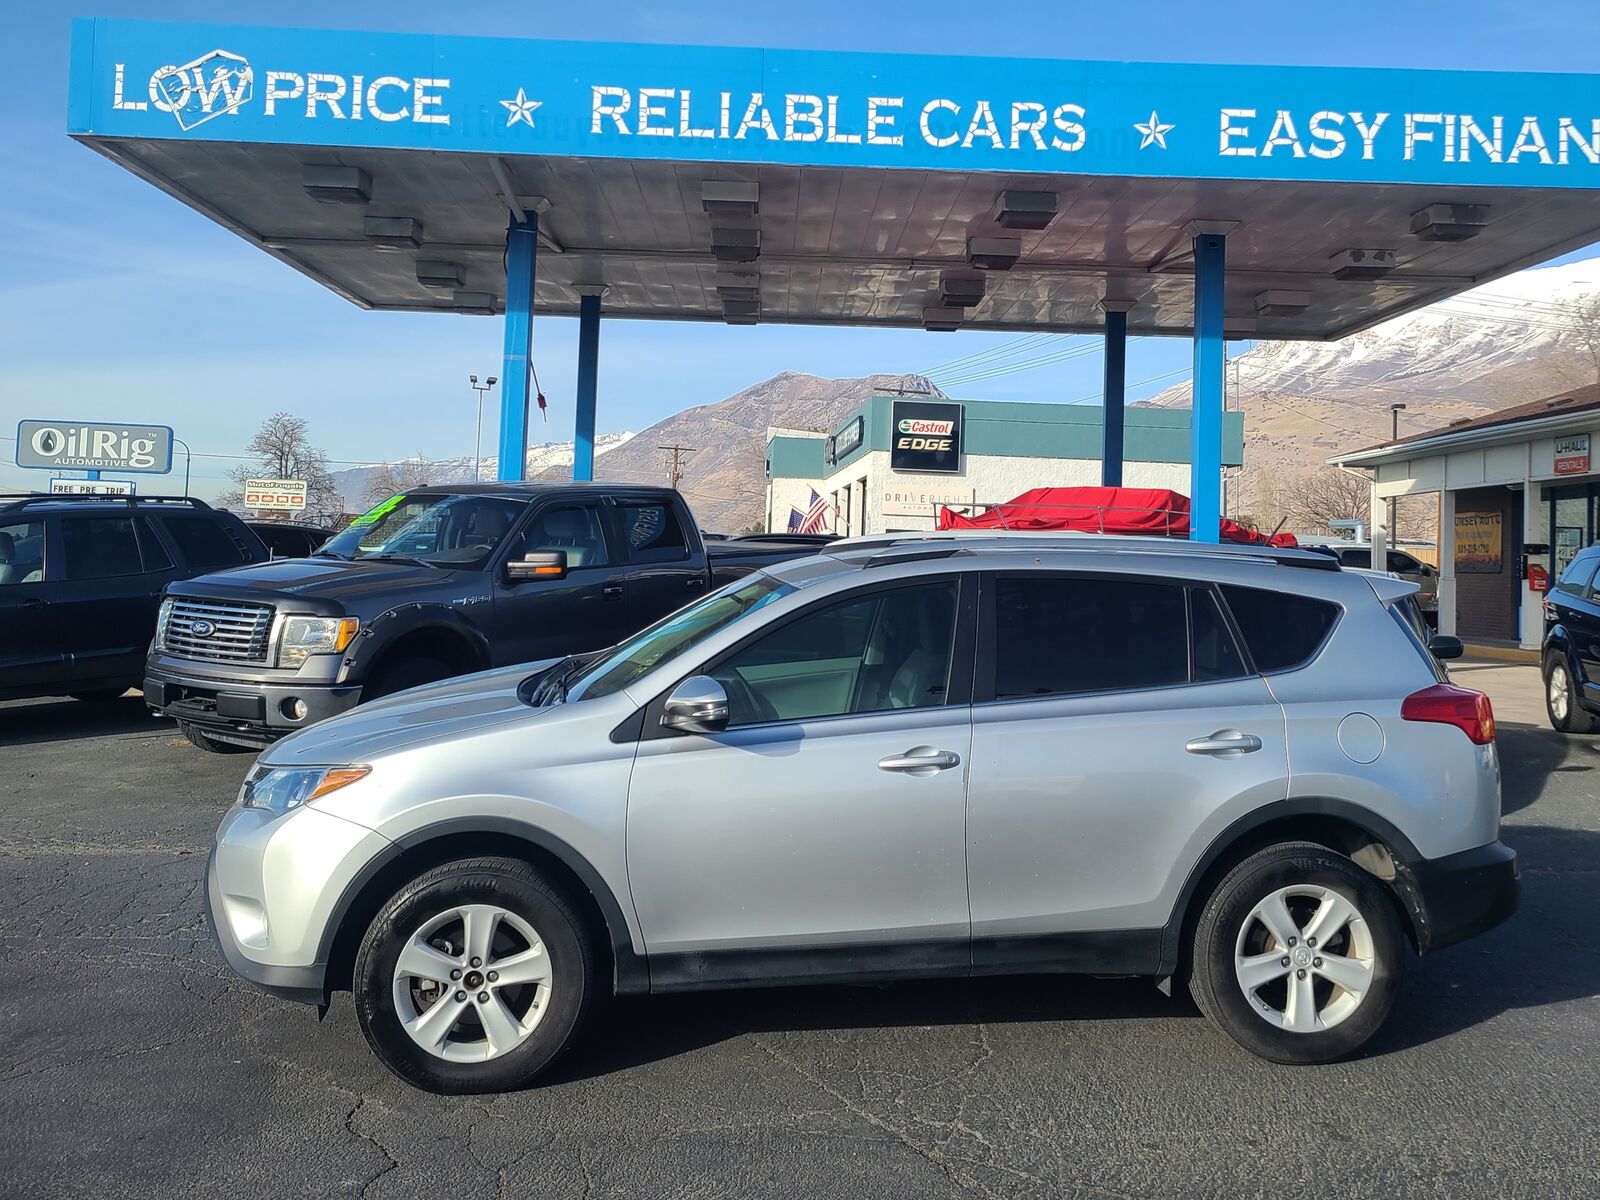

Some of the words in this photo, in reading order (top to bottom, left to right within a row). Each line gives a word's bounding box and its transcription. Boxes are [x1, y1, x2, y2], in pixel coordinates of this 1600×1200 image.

[112, 63, 249, 115] LOW
[263, 71, 451, 125] PRICE
[591, 84, 904, 146] RELIABLE
[919, 98, 1087, 152] CARS
[1219, 108, 1390, 160] EASY
[1402, 112, 1600, 165] FINAN
[911, 421, 950, 433] Castrol
[31, 427, 156, 468] OilRig
[897, 437, 953, 451] EDGE
[54, 457, 128, 467] AUTOMOTIVE
[1558, 460, 1585, 472] RENTALS
[53, 485, 74, 493] FREE
[80, 486, 97, 494] PRE
[105, 487, 125, 495] TRIP
[885, 491, 970, 502] DRIVERIGHT
[1455, 516, 1477, 526] UNSET
